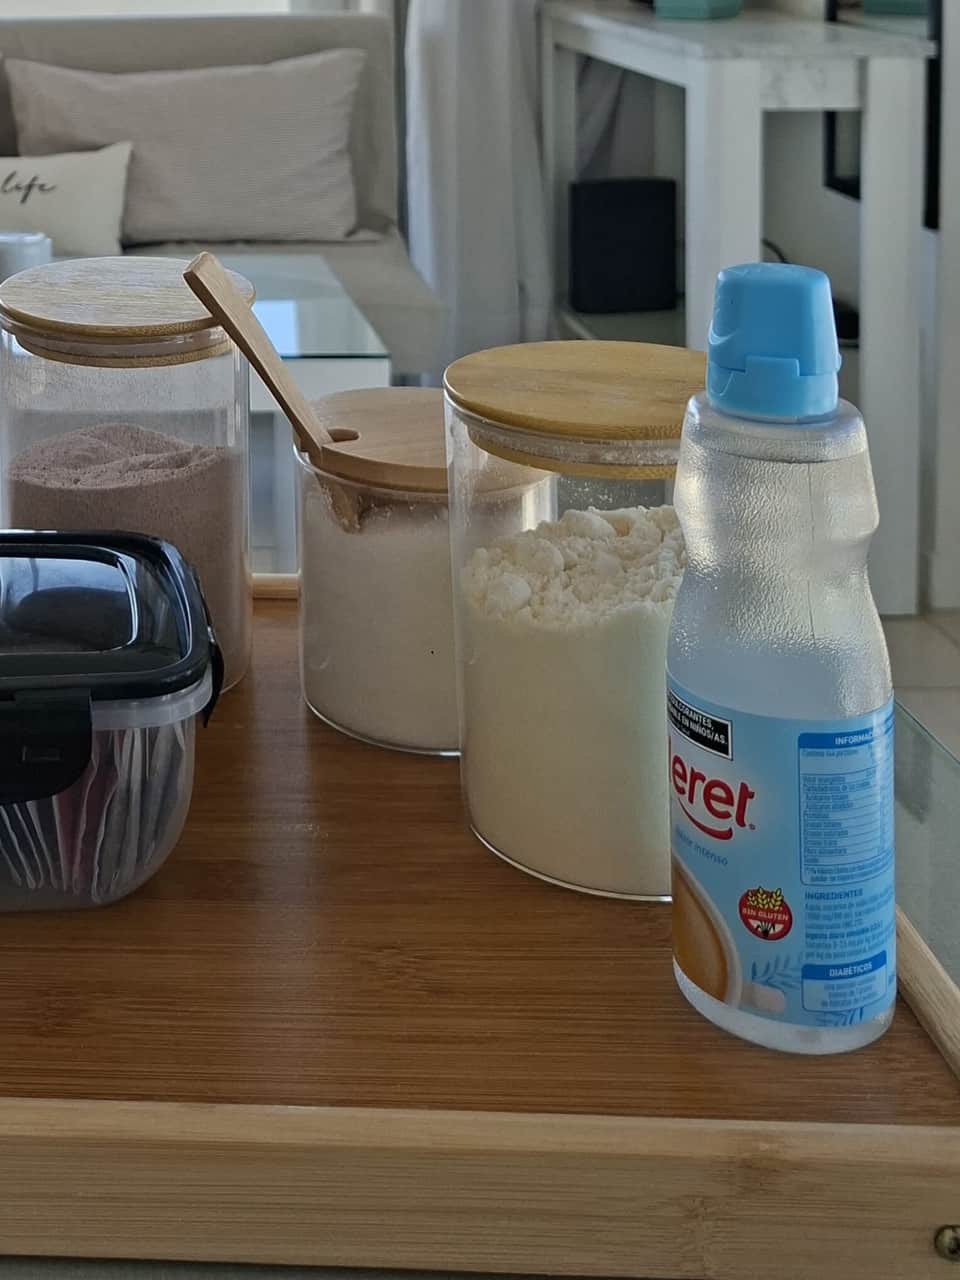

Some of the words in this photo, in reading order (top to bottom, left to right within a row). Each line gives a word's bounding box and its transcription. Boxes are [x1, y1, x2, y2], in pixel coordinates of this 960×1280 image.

[0, 170, 57, 205] life
[743, 907, 756, 916] SIN
[758, 910, 789, 921] GLUTEN
[829, 962, 872, 977] DIABÉTICOS
